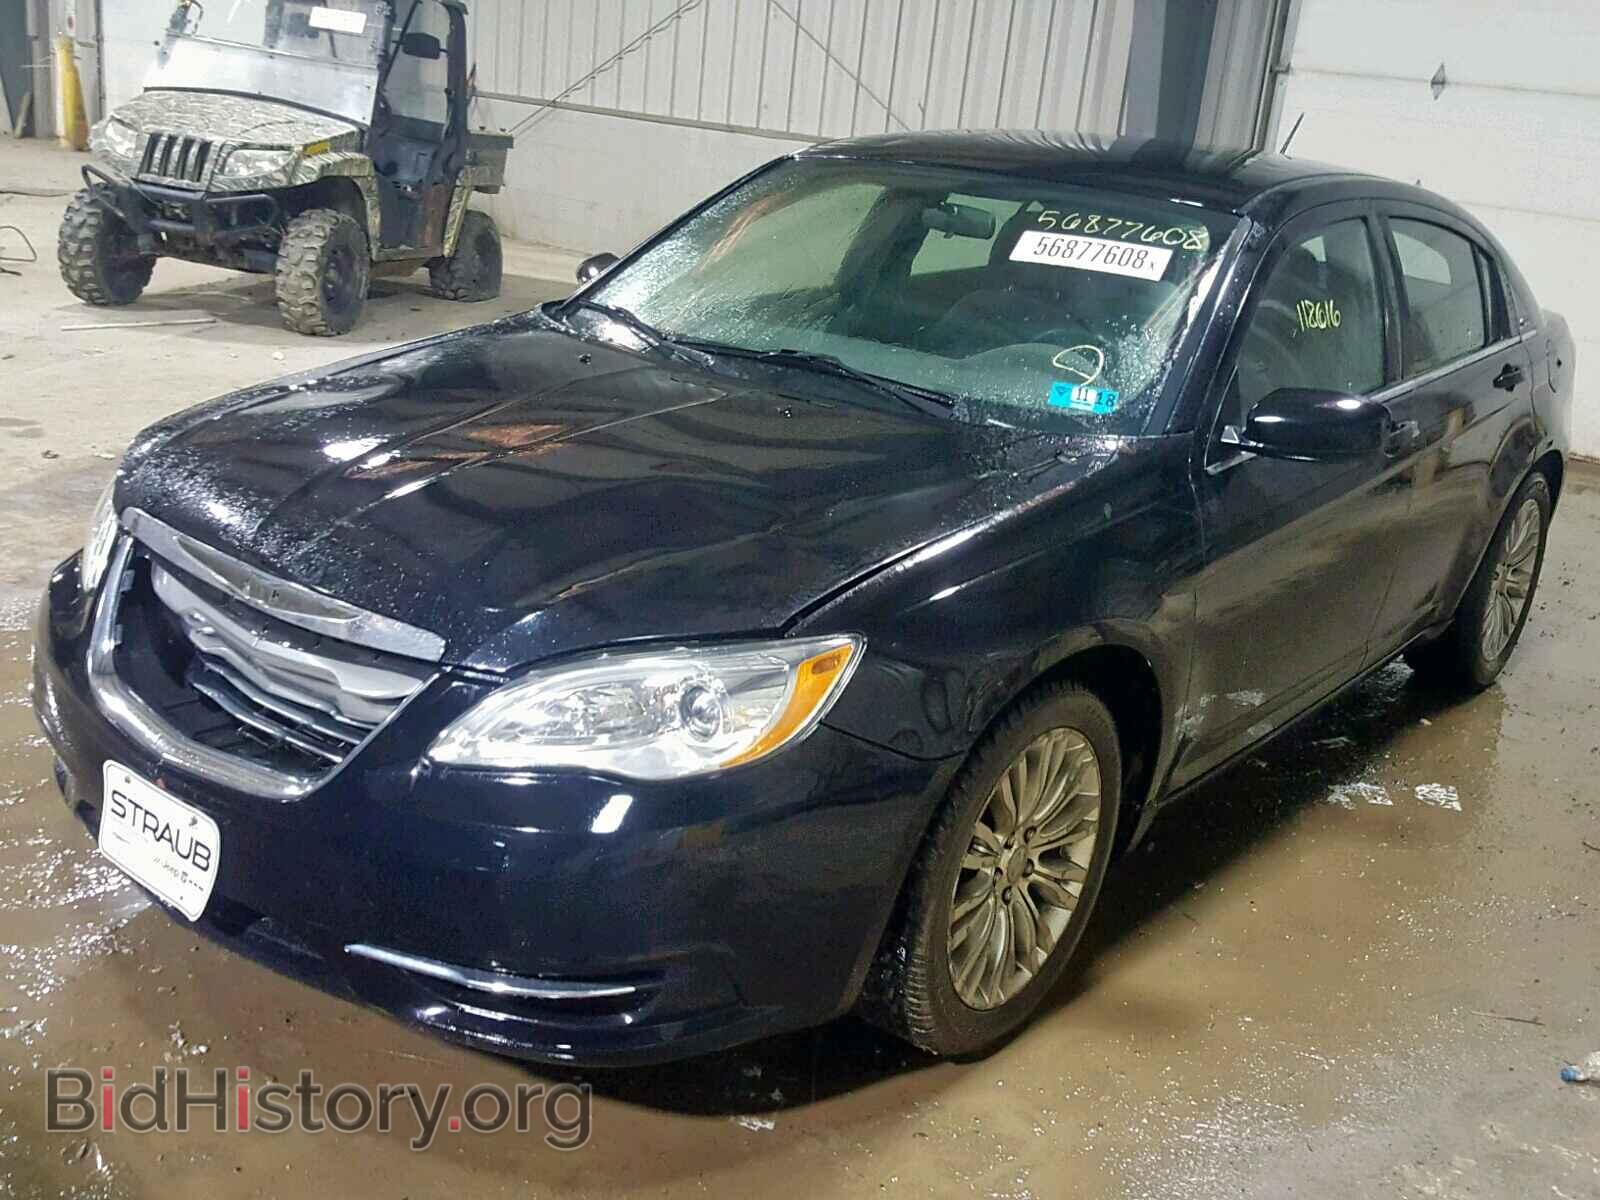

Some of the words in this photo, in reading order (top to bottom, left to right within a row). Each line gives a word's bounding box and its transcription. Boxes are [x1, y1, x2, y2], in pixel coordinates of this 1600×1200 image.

[1037, 210, 1210, 250] 56877608
[1034, 236, 1149, 269] 56877608
[111, 790, 212, 872] STRAUB
